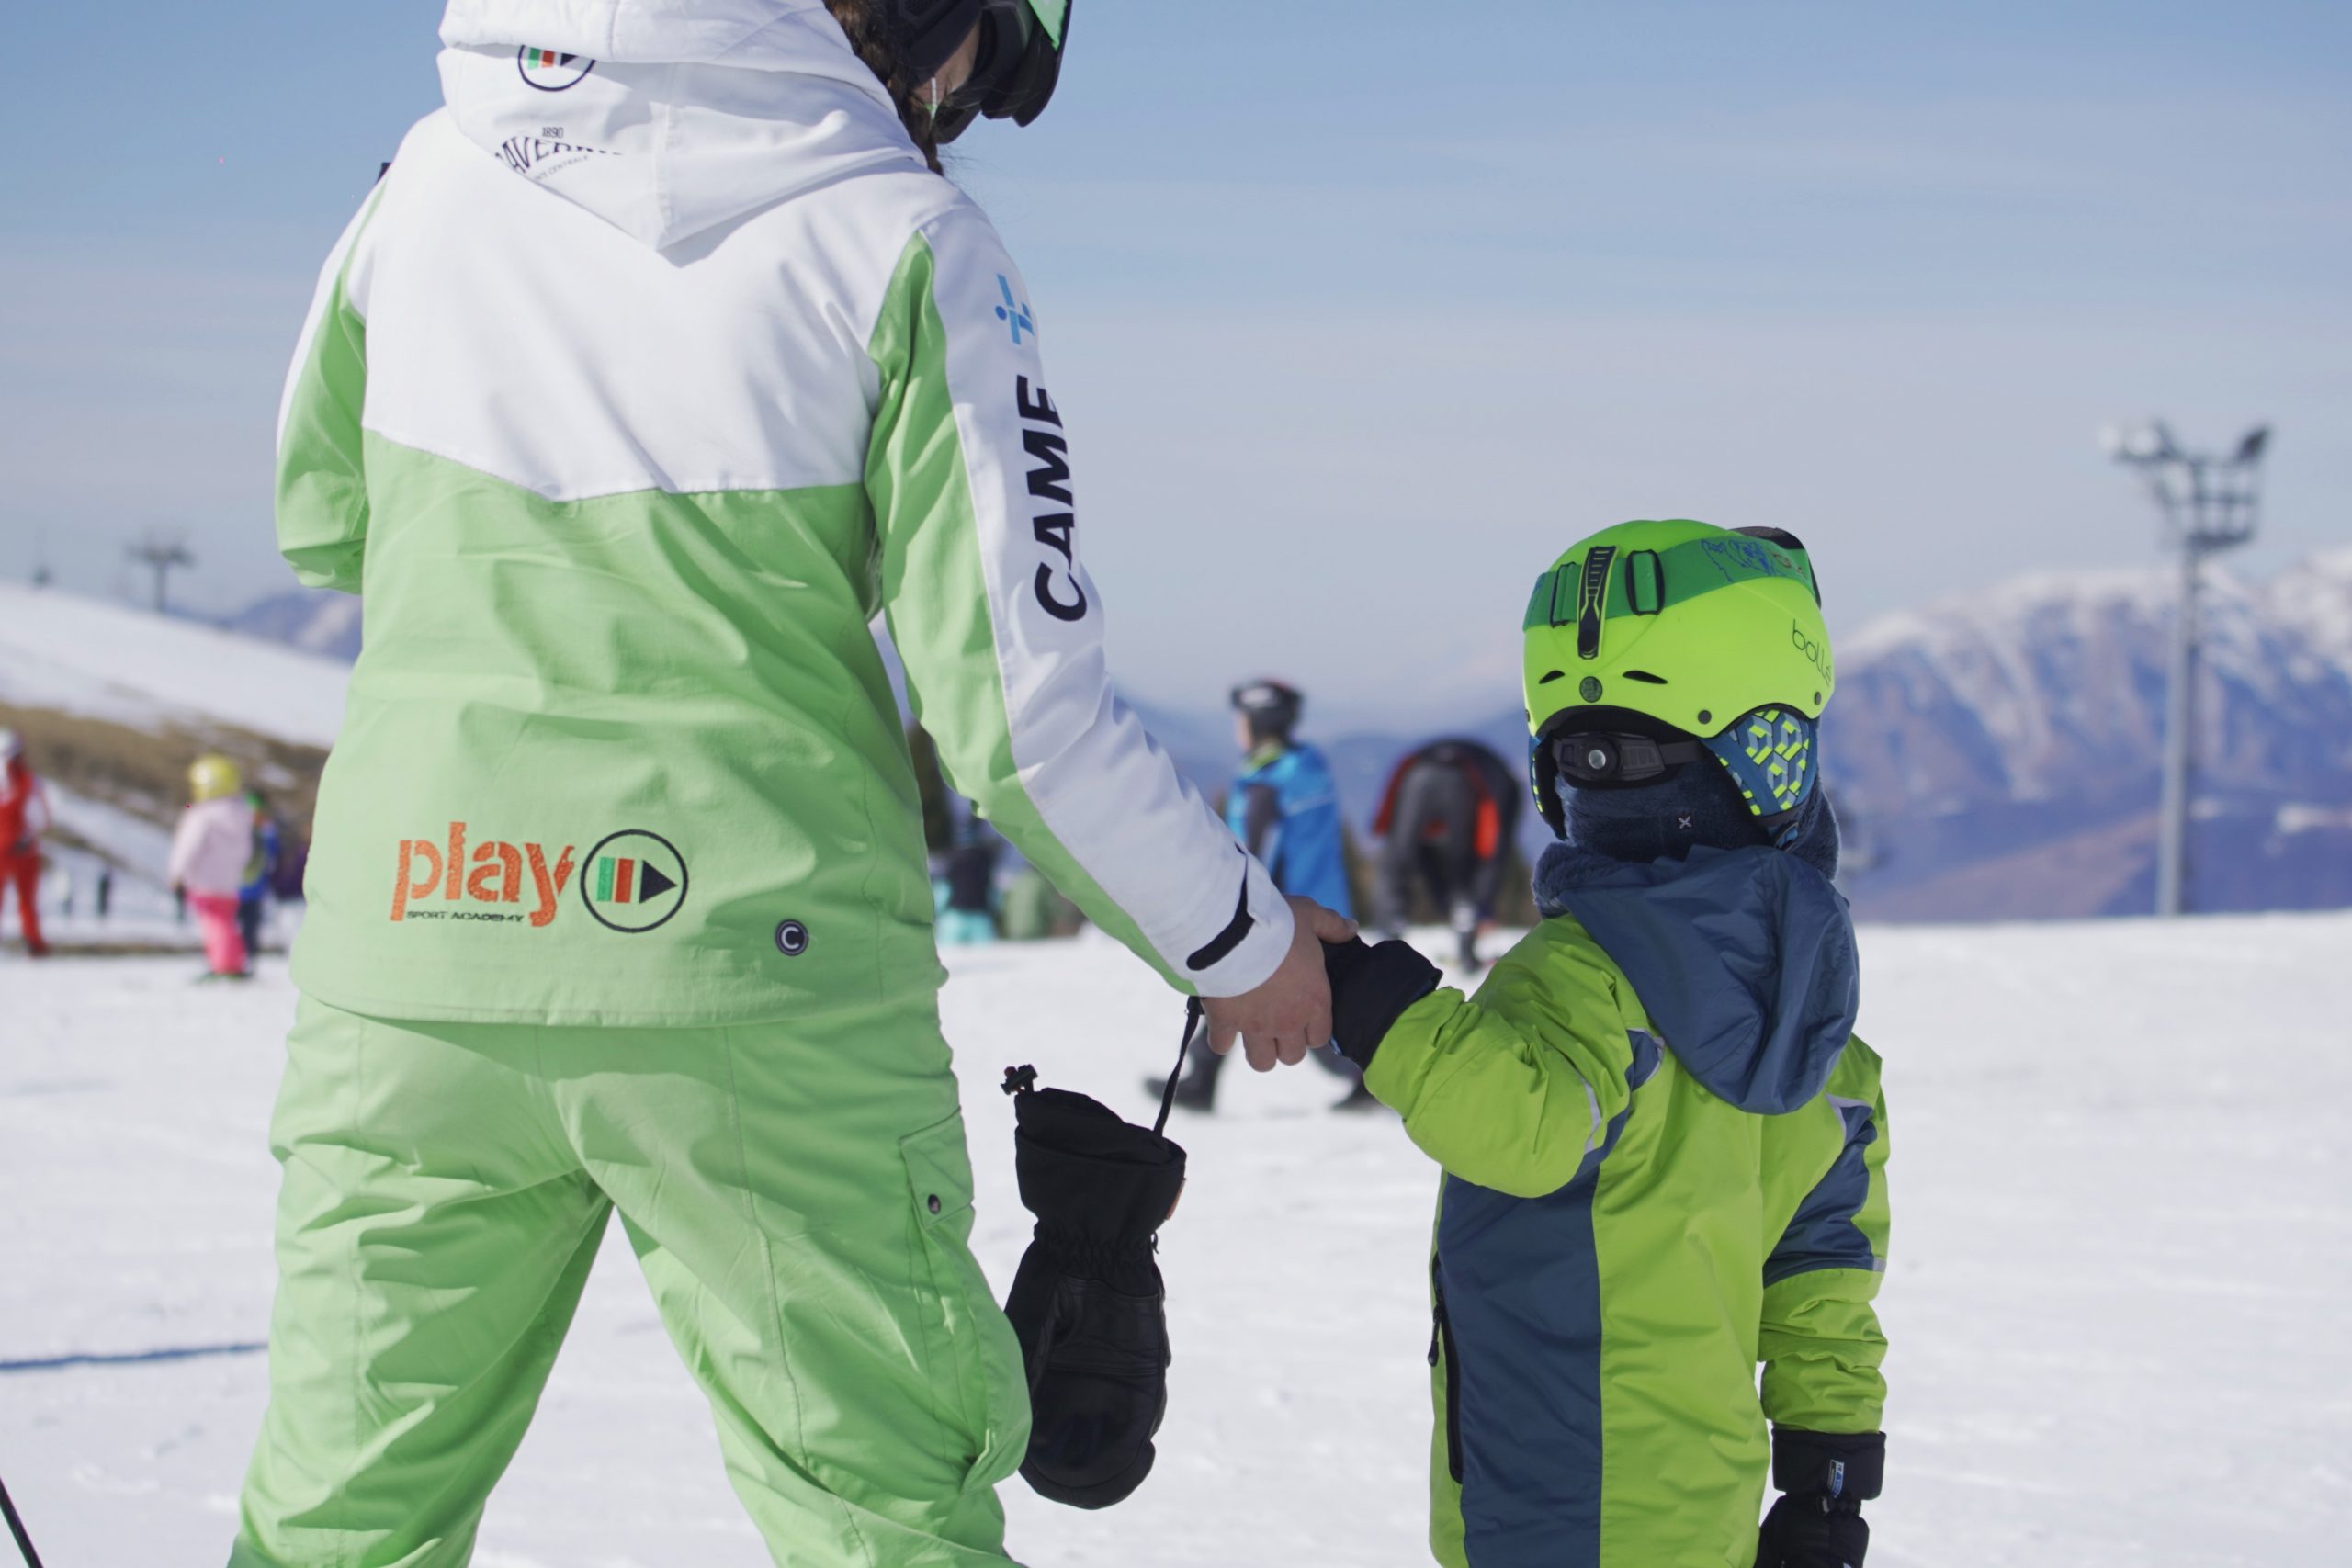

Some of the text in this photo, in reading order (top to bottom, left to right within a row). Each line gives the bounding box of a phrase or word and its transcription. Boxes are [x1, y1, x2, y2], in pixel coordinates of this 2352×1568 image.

[1016, 374, 1088, 622] CAME
[390, 822, 575, 927] play
[406, 910, 524, 922] SPORT ACADEMY
[781, 926, 799, 950] C
